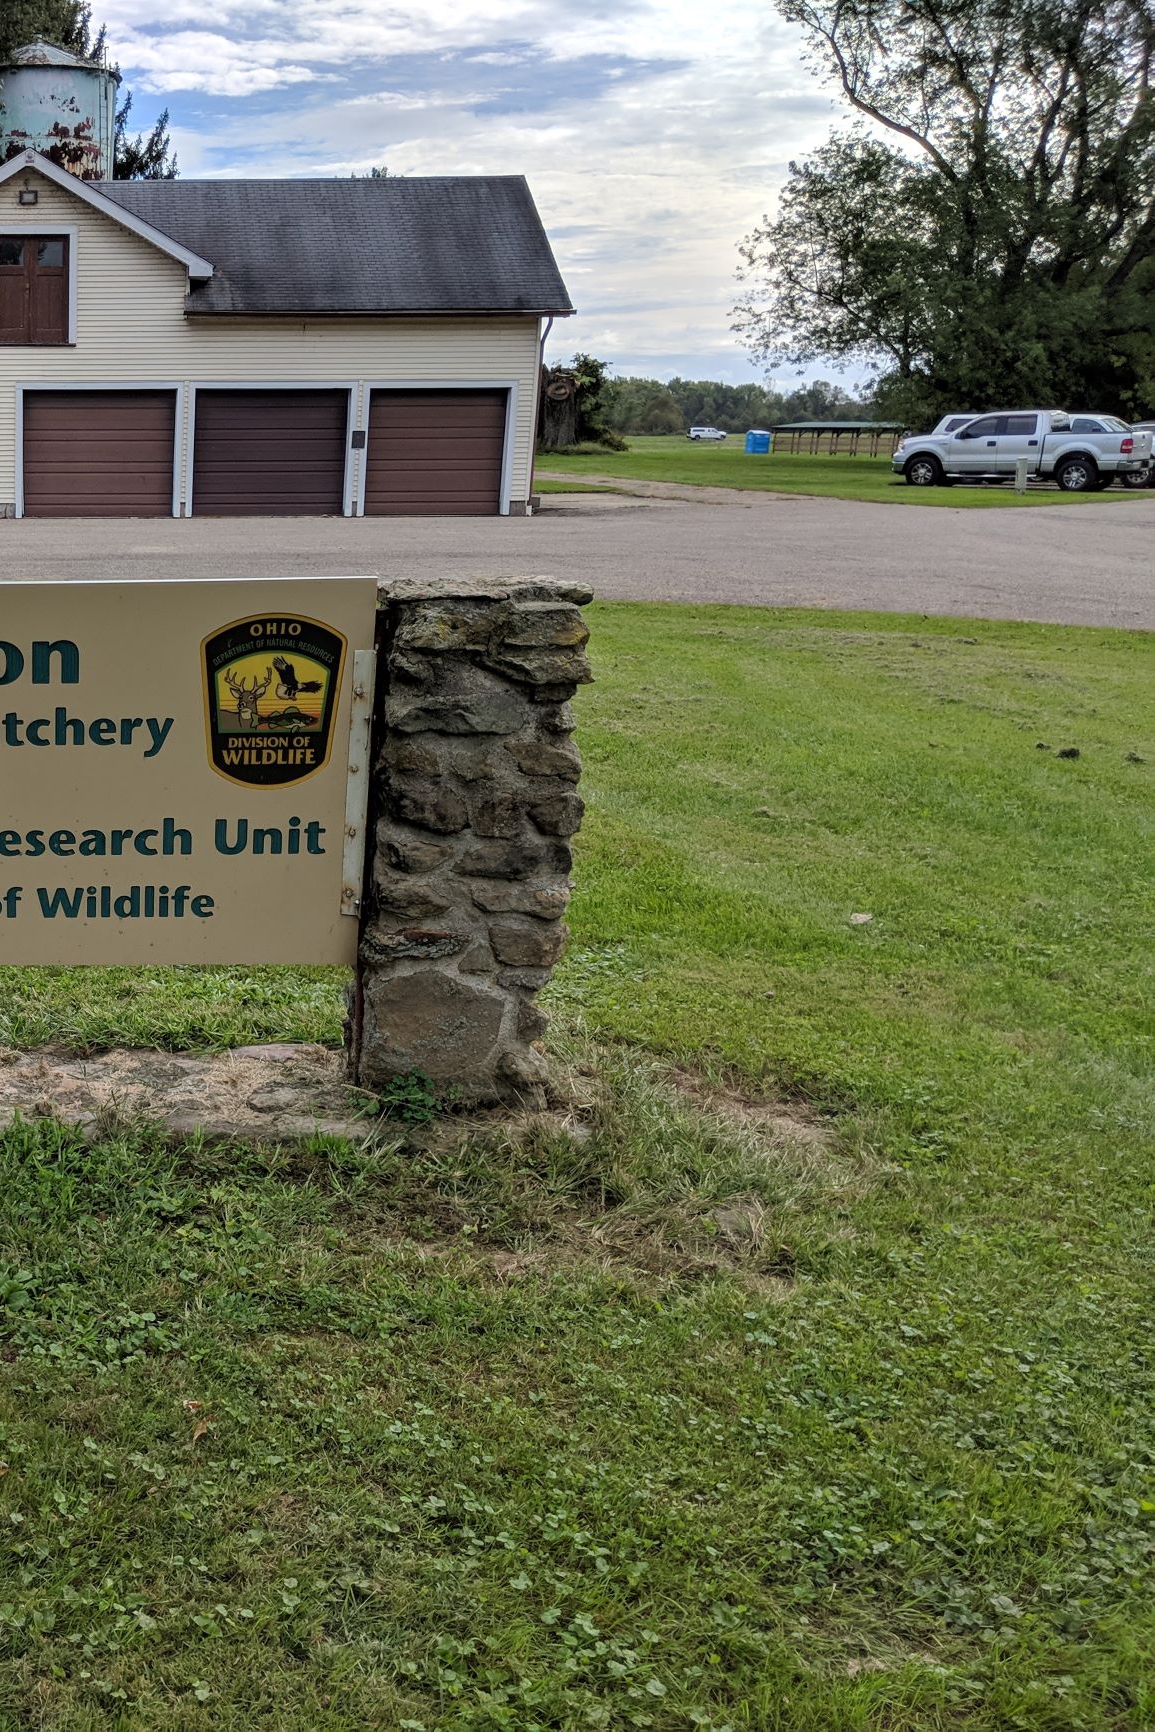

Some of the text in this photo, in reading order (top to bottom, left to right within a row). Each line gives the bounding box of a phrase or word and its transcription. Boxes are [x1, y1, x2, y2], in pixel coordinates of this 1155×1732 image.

[249, 622, 302, 636] OHIO
[212, 638, 335, 666] DEPARTMENT OF NATURAL RESOURCES
[228, 736, 311, 748] DIVISION OF
[222, 749, 316, 765] WILDLIFE
[214, 815, 327, 856] Unit
[36, 885, 215, 919] Wildlife
